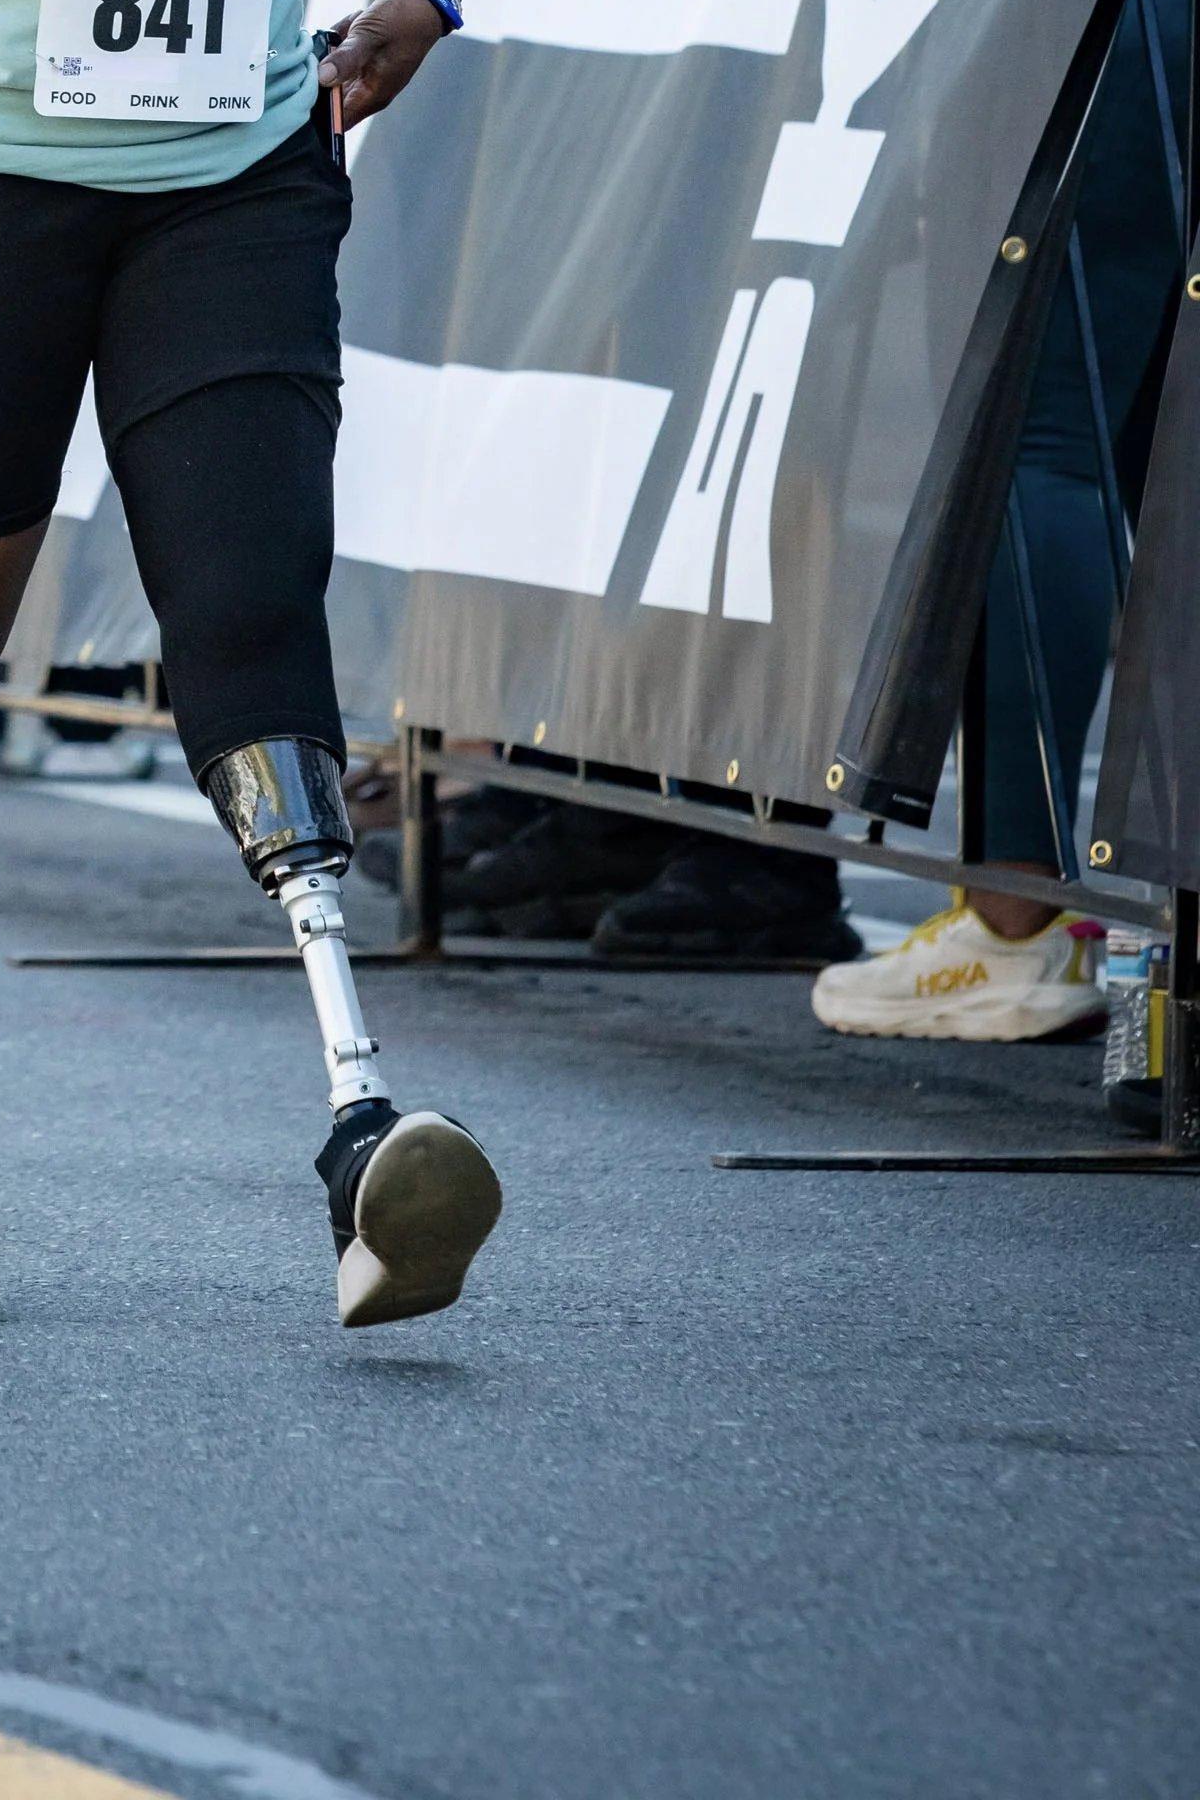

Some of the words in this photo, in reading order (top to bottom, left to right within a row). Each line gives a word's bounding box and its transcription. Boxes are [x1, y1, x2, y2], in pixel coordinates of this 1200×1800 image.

[51, 91, 96, 105] FOOD
[130, 94, 179, 109] DRINK
[208, 96, 252, 109] DRINK
[916, 960, 989, 998] HOKA
